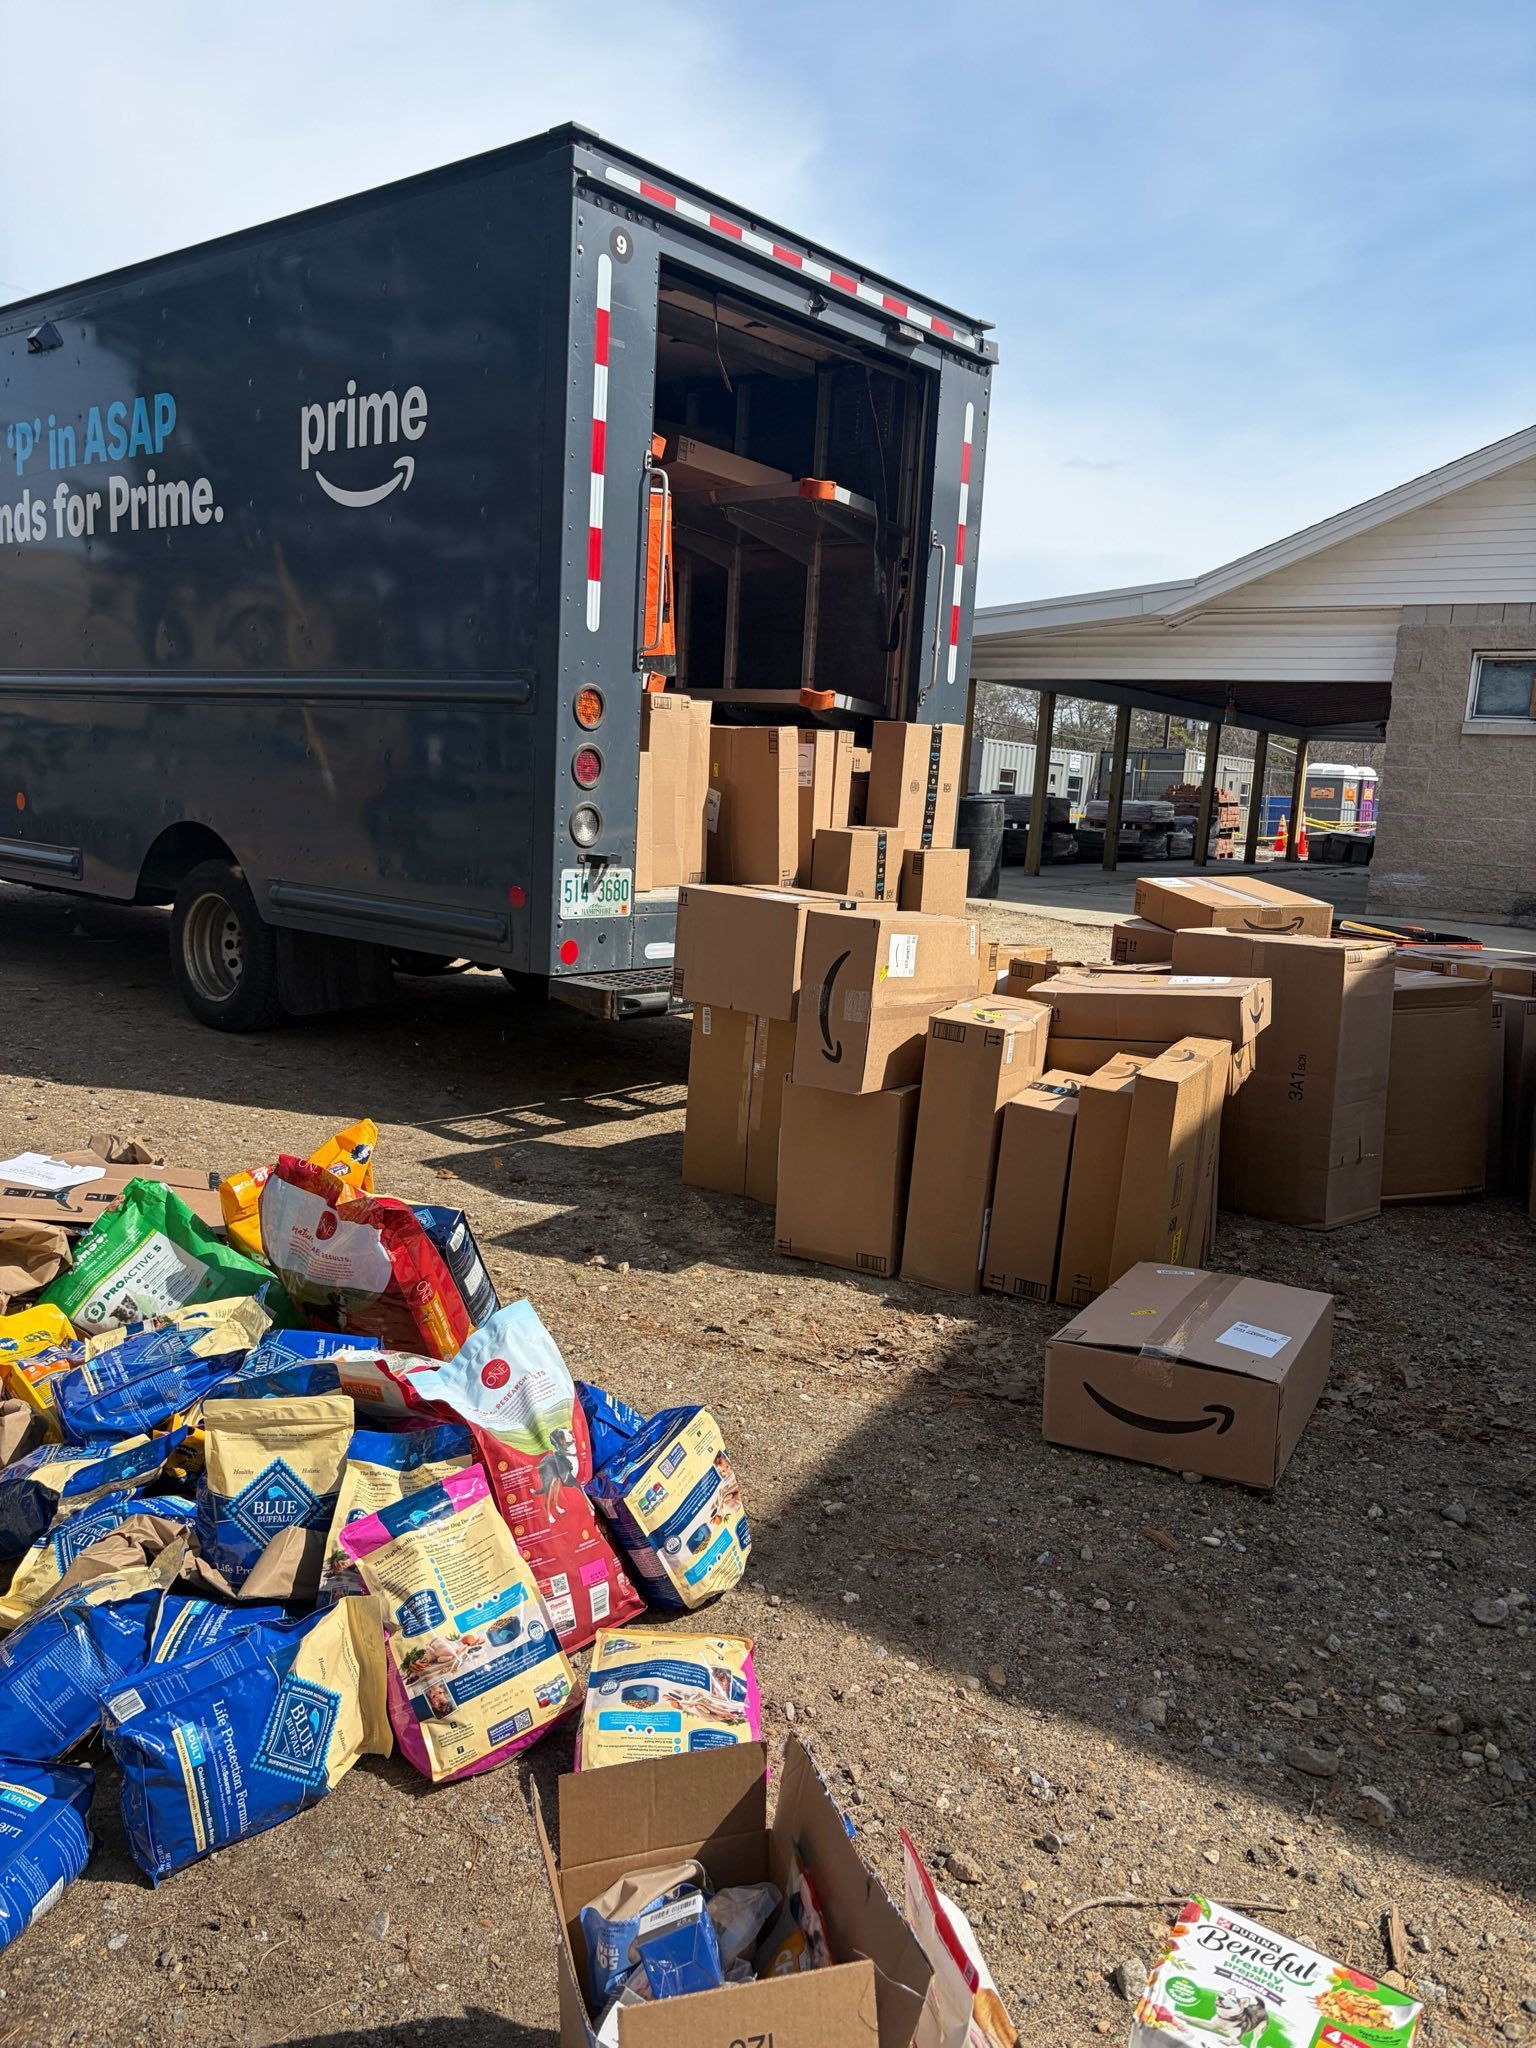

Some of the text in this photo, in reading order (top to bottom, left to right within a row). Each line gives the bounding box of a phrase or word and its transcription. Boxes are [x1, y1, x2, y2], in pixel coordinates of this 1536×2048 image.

[616, 234, 628, 254] 9
[48, 414, 77, 471] in
[84, 392, 177, 464] ASAP
[301, 379, 428, 470] prime
[53, 482, 101, 538] for
[109, 469, 224, 533] Prime.
[597, 878, 629, 902] 3680
[103, 1244, 162, 1301] PROACTIVE 5
[486, 1363, 508, 1386] ONE
[253, 1500, 298, 1515] BLUE
[257, 1515, 295, 1523] BUFFALO
[285, 1717, 300, 1758] BUFFALO
[291, 1702, 314, 1756] BLUE
[185, 1727, 202, 1762] ADULT
[195, 1766, 209, 1790] Chicken
[212, 1699, 252, 1834] Life Protection Formula
[4, 1793, 35, 1808] ADULT
[1197, 1924, 1318, 1980] Beneful
[1232, 1923, 1282, 1952] PURINA
[1223, 1961, 1285, 1993] prepared
[1230, 1954, 1285, 1985] freshly
[1231, 1973, 1269, 1997] blends
[1325, 2030, 1342, 2043] 4
